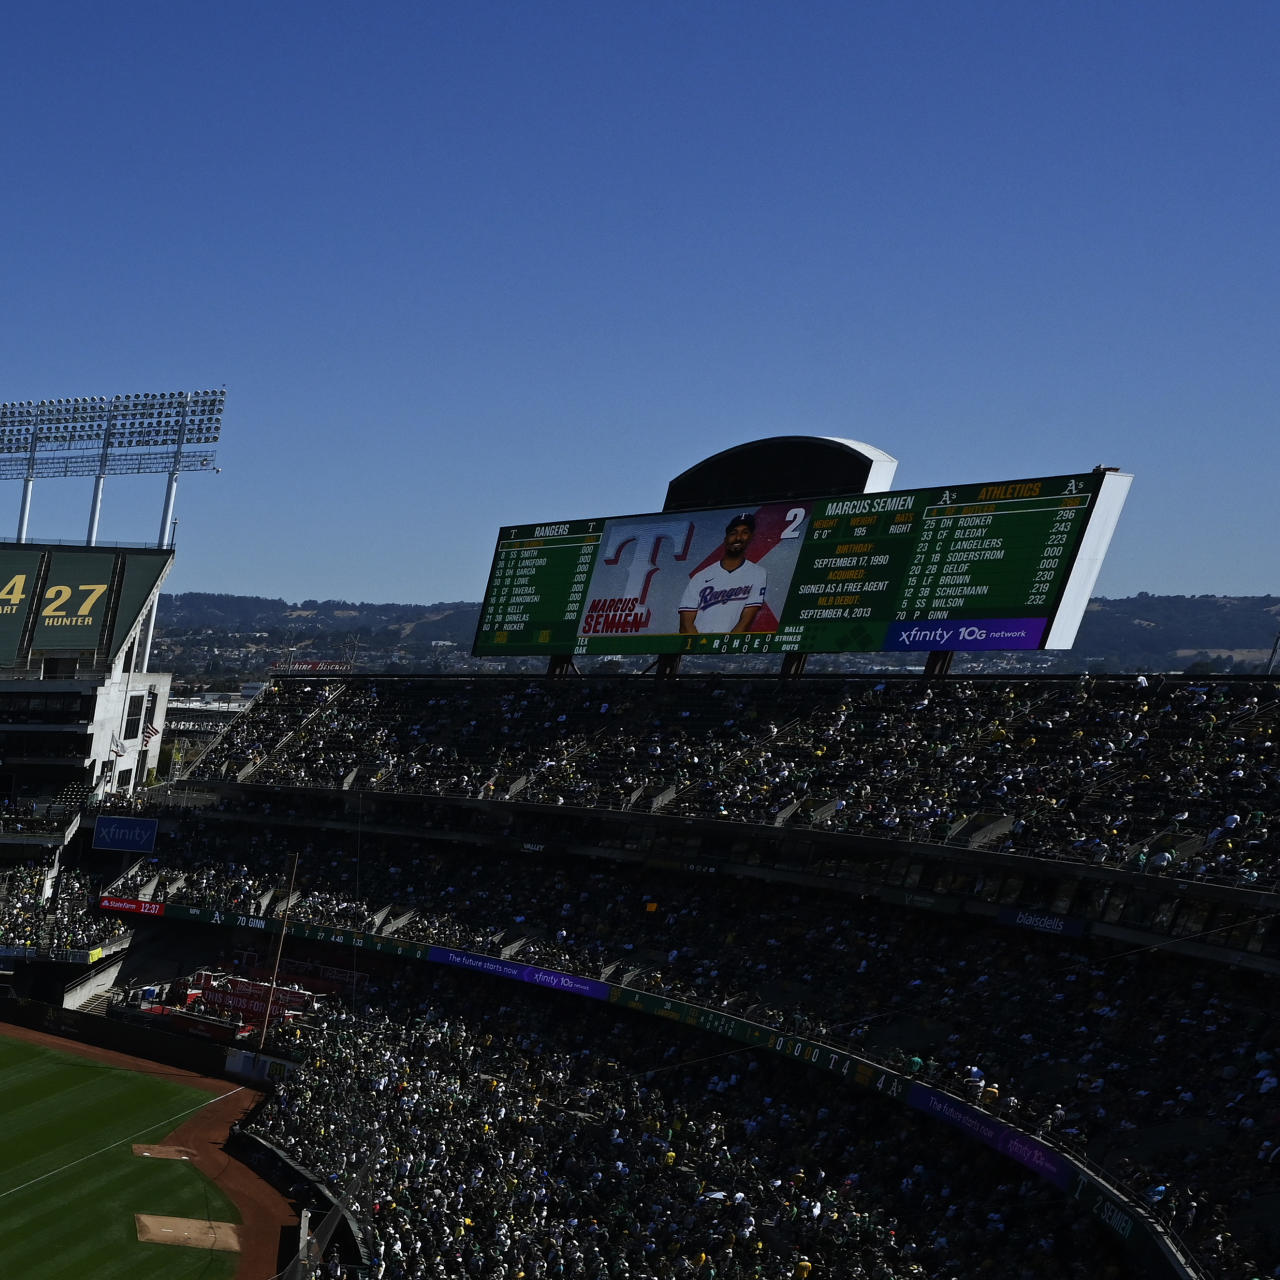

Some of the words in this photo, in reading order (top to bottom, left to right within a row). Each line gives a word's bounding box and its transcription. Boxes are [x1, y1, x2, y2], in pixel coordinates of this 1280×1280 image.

[978, 482, 1042, 500] ATHLETICS
[825, 500, 871, 516] MARCUS
[871, 496, 914, 513] SEMIEN
[781, 507, 806, 539] 2
[924, 519, 936, 528] 25
[941, 518, 953, 528] DH
[958, 516, 992, 527] ROOKER
[1054, 510, 1076, 520] .296
[921, 531, 932, 541] 33
[937, 530, 949, 540] CF
[954, 528, 988, 538] BLEDAY
[1050, 522, 1072, 532] .243
[917, 543, 928, 552] 23
[936, 542, 942, 551] C
[951, 539, 1003, 550] LANGELIERS
[1045, 534, 1067, 545] .223
[813, 557, 856, 568] SEPTEMBER
[868, 555, 889, 566] 1990
[914, 555, 925, 564] 21
[931, 554, 940, 562] 1B
[946, 550, 1005, 562] SODERSTROM
[1041, 547, 1063, 557] .000
[909, 566, 921, 575] 20
[926, 565, 937, 574] 2B
[943, 563, 971, 573] GELOF
[1037, 559, 1059, 569] .000
[908, 577, 917, 586] 15
[922, 576, 934, 585] LF
[940, 575, 971, 585] BROWN
[1033, 571, 1055, 581] .230
[904, 589, 913, 597] 12
[918, 587, 930, 596] 3B
[936, 586, 989, 596] SCHUEMANN
[1029, 583, 1050, 593] .219
[42, 584, 108, 616] 27
[588, 597, 638, 613] MARCUS
[902, 600, 908, 608] 5
[915, 599, 926, 608] SS
[932, 597, 964, 607] WILSON
[1024, 595, 1046, 605] .232
[44, 616, 93, 626] HUNTER
[582, 612, 642, 634] SEMIEN
[895, 611, 906, 620] 70
[913, 611, 920, 620] P
[927, 610, 949, 620] GINN
[898, 628, 953, 645] xfinity
[958, 626, 987, 640] 10G
[990, 630, 1027, 639] network
[99, 824, 152, 844] xfinity
[140, 903, 160, 914] 12:37
[236, 916, 246, 926] 70
[248, 918, 266, 929] GINN
[449, 953, 461, 964] The
[462, 956, 483, 968] future
[483, 960, 502, 973] starts
[503, 966, 518, 976] now
[534, 972, 559, 986] xfinity
